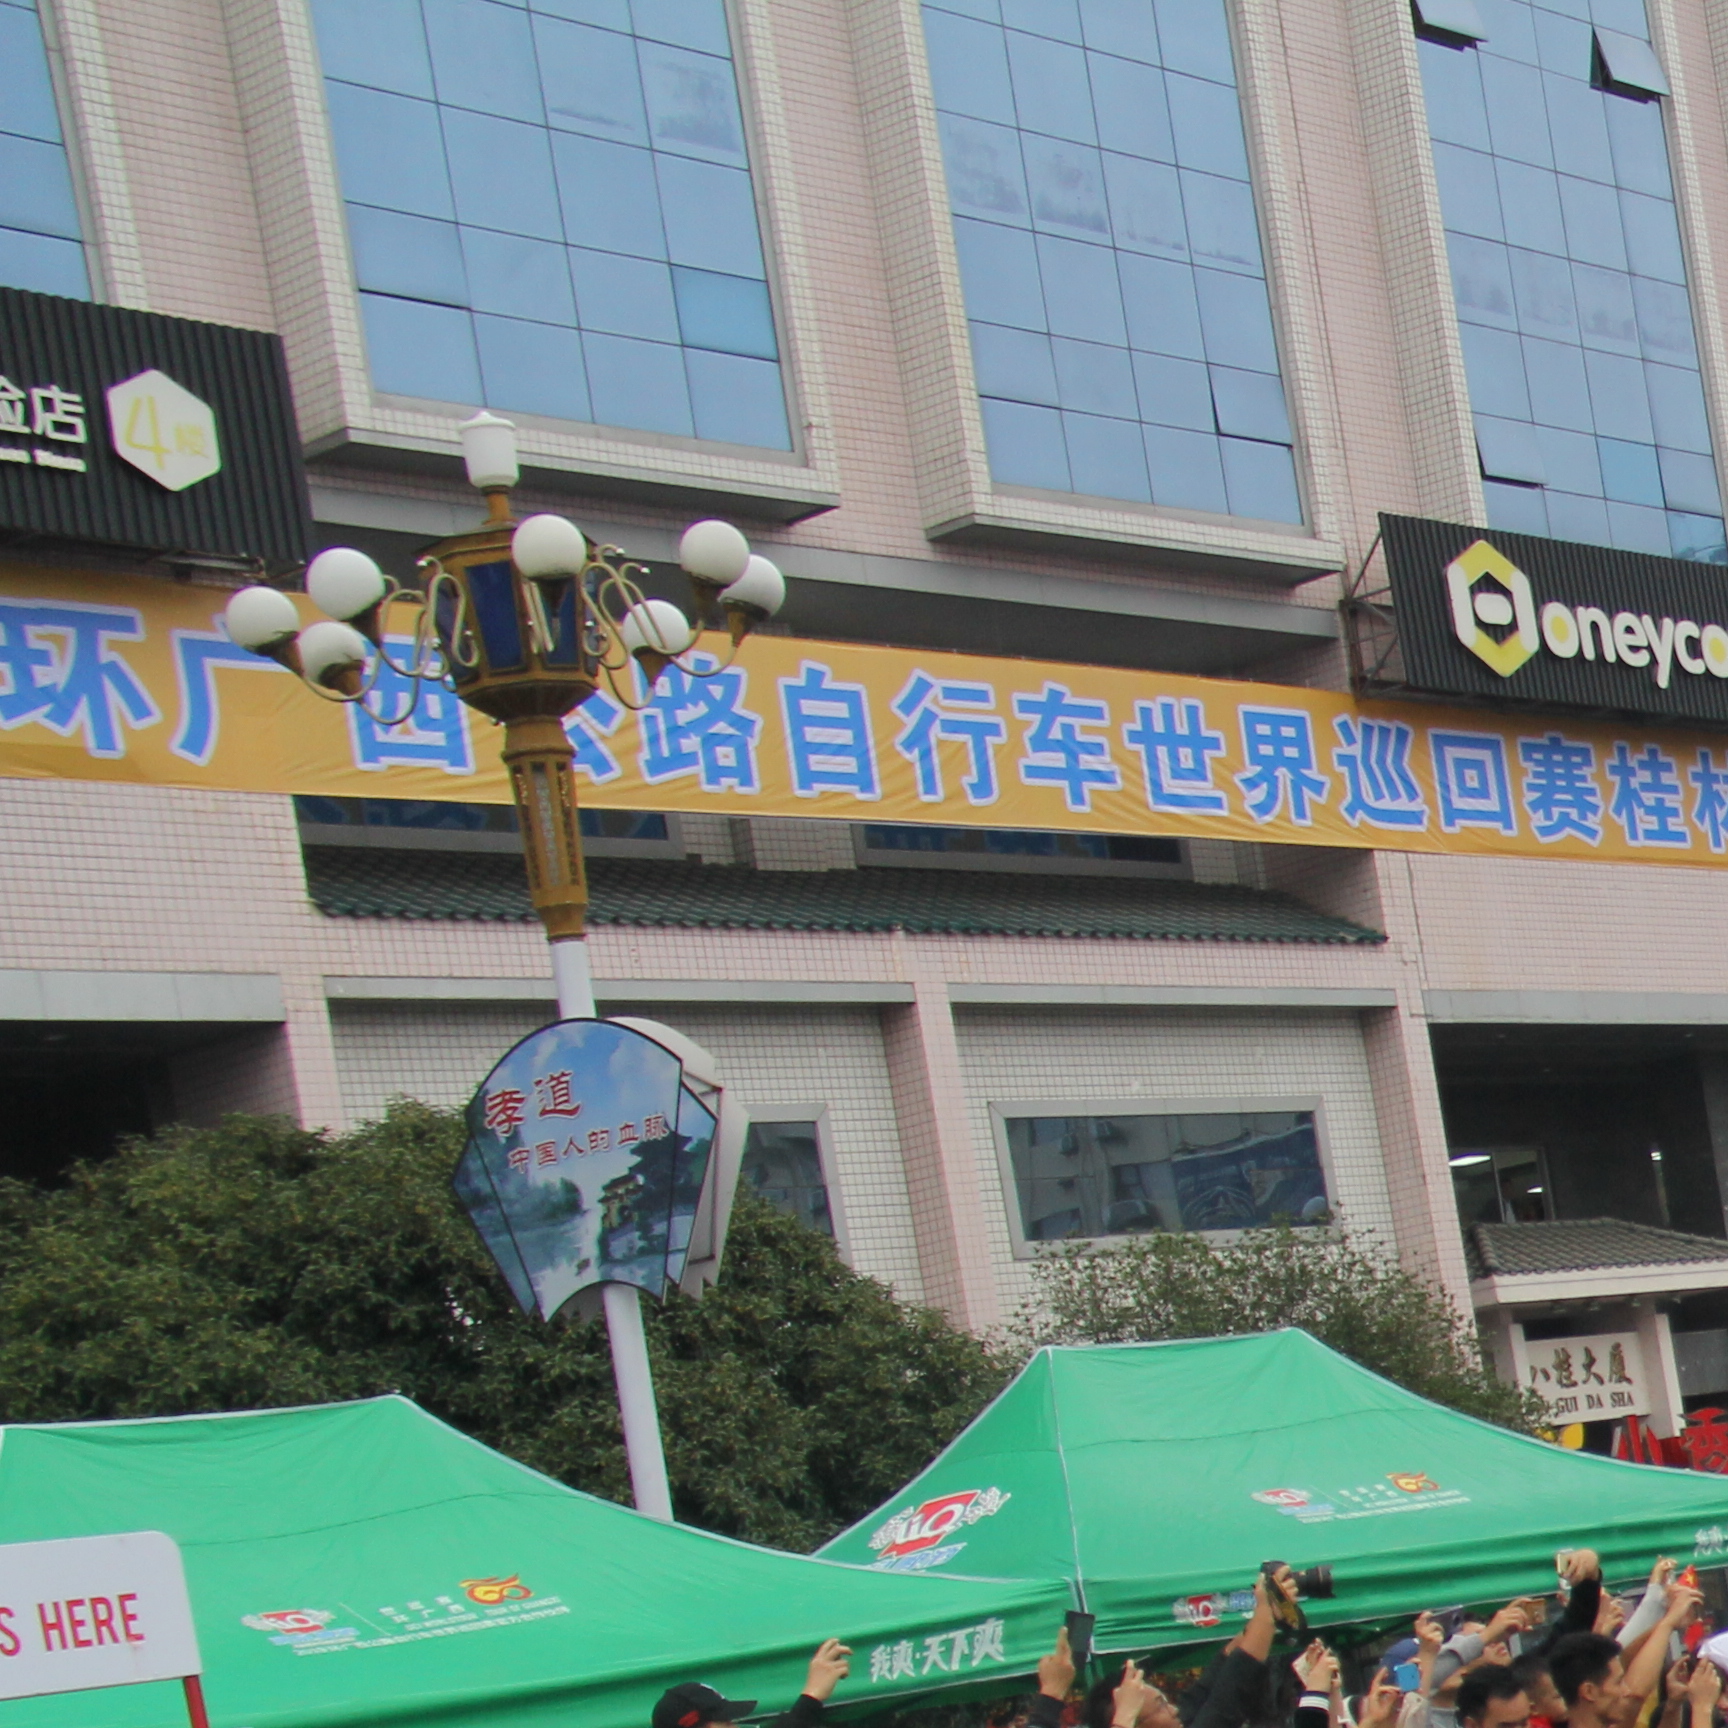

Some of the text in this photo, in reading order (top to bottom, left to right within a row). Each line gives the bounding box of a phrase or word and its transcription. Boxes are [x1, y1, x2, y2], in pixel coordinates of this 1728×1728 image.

[484, 1069, 582, 1136] 孝道
[508, 1112, 669, 1175] 中国人的血脉
[1586, 1392, 1605, 1411] DA
[1610, 1389, 1634, 1408] SHA
[37, 1592, 146, 1653] HERE
